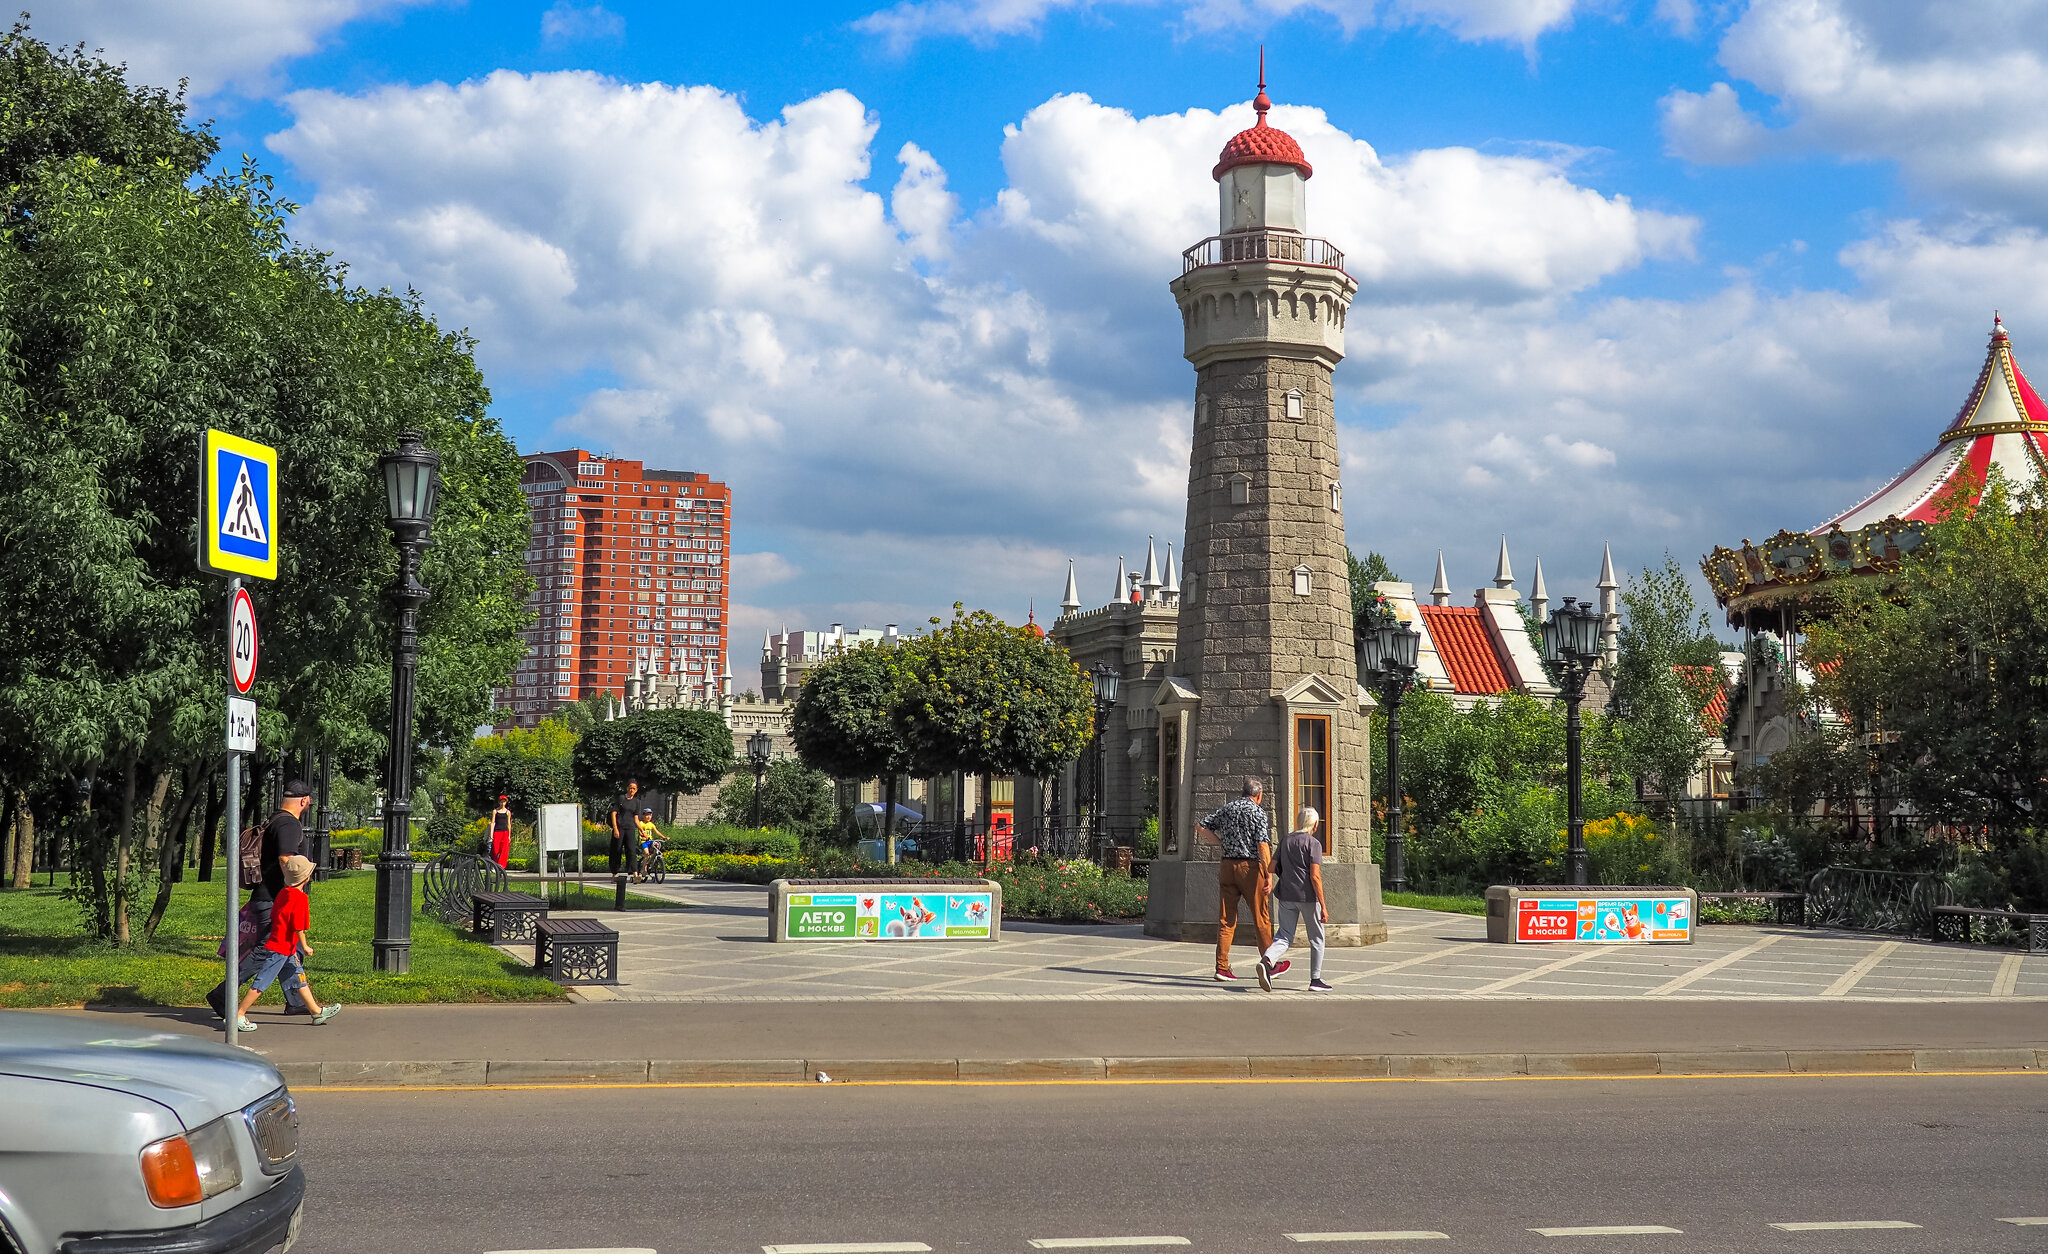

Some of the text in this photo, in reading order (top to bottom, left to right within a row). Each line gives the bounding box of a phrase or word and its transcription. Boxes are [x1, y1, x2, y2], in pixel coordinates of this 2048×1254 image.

[236, 619, 250, 661] 20
[799, 911, 845, 923] ЛЕТО
[1528, 915, 1568, 927] ЛЕТО
[798, 925, 845, 933] В МОСКВЕ
